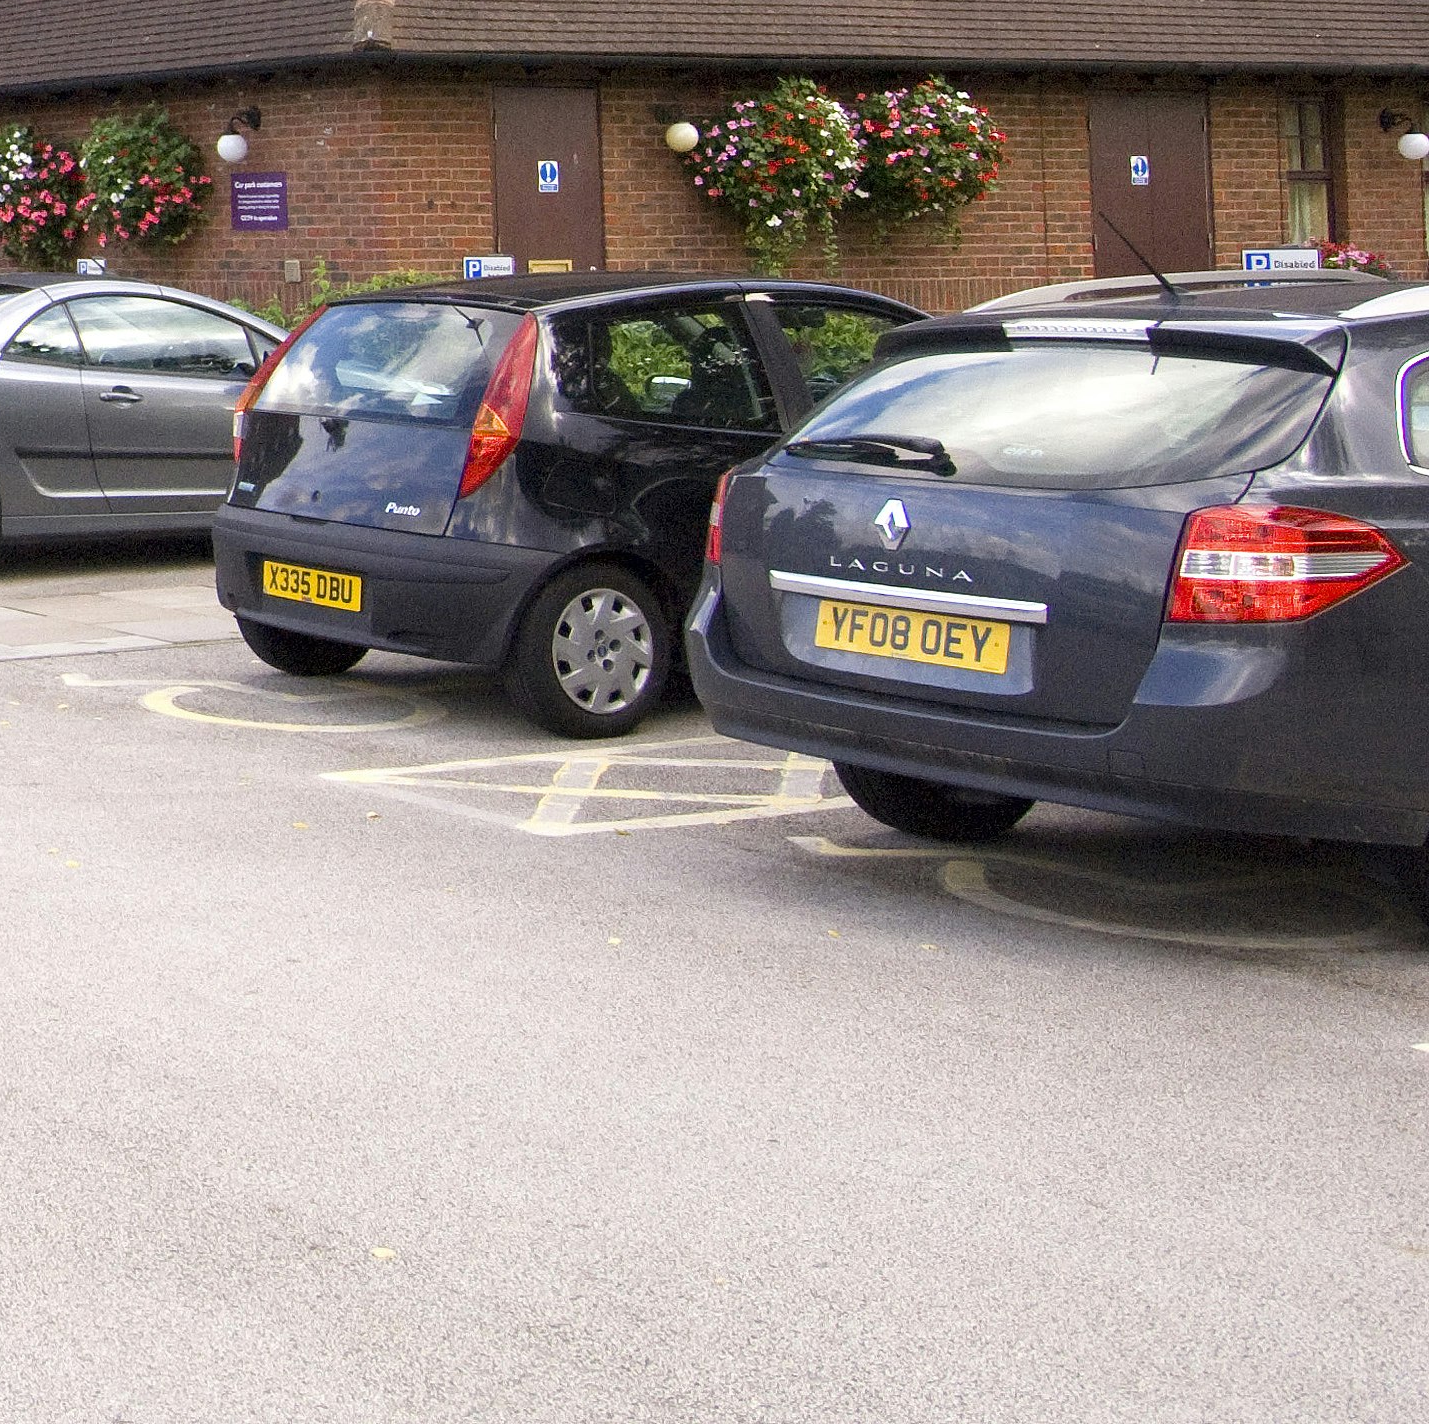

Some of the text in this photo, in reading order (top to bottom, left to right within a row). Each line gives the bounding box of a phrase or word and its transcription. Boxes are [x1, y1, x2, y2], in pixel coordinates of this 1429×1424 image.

[484, 264, 511, 272] Disabled
[1274, 260, 1316, 269] Disabled
[385, 501, 421, 517] Punto
[829, 555, 973, 583] LAGUNA
[269, 564, 353, 604] X335 DBU
[832, 606, 992, 663] YF08 OEY
